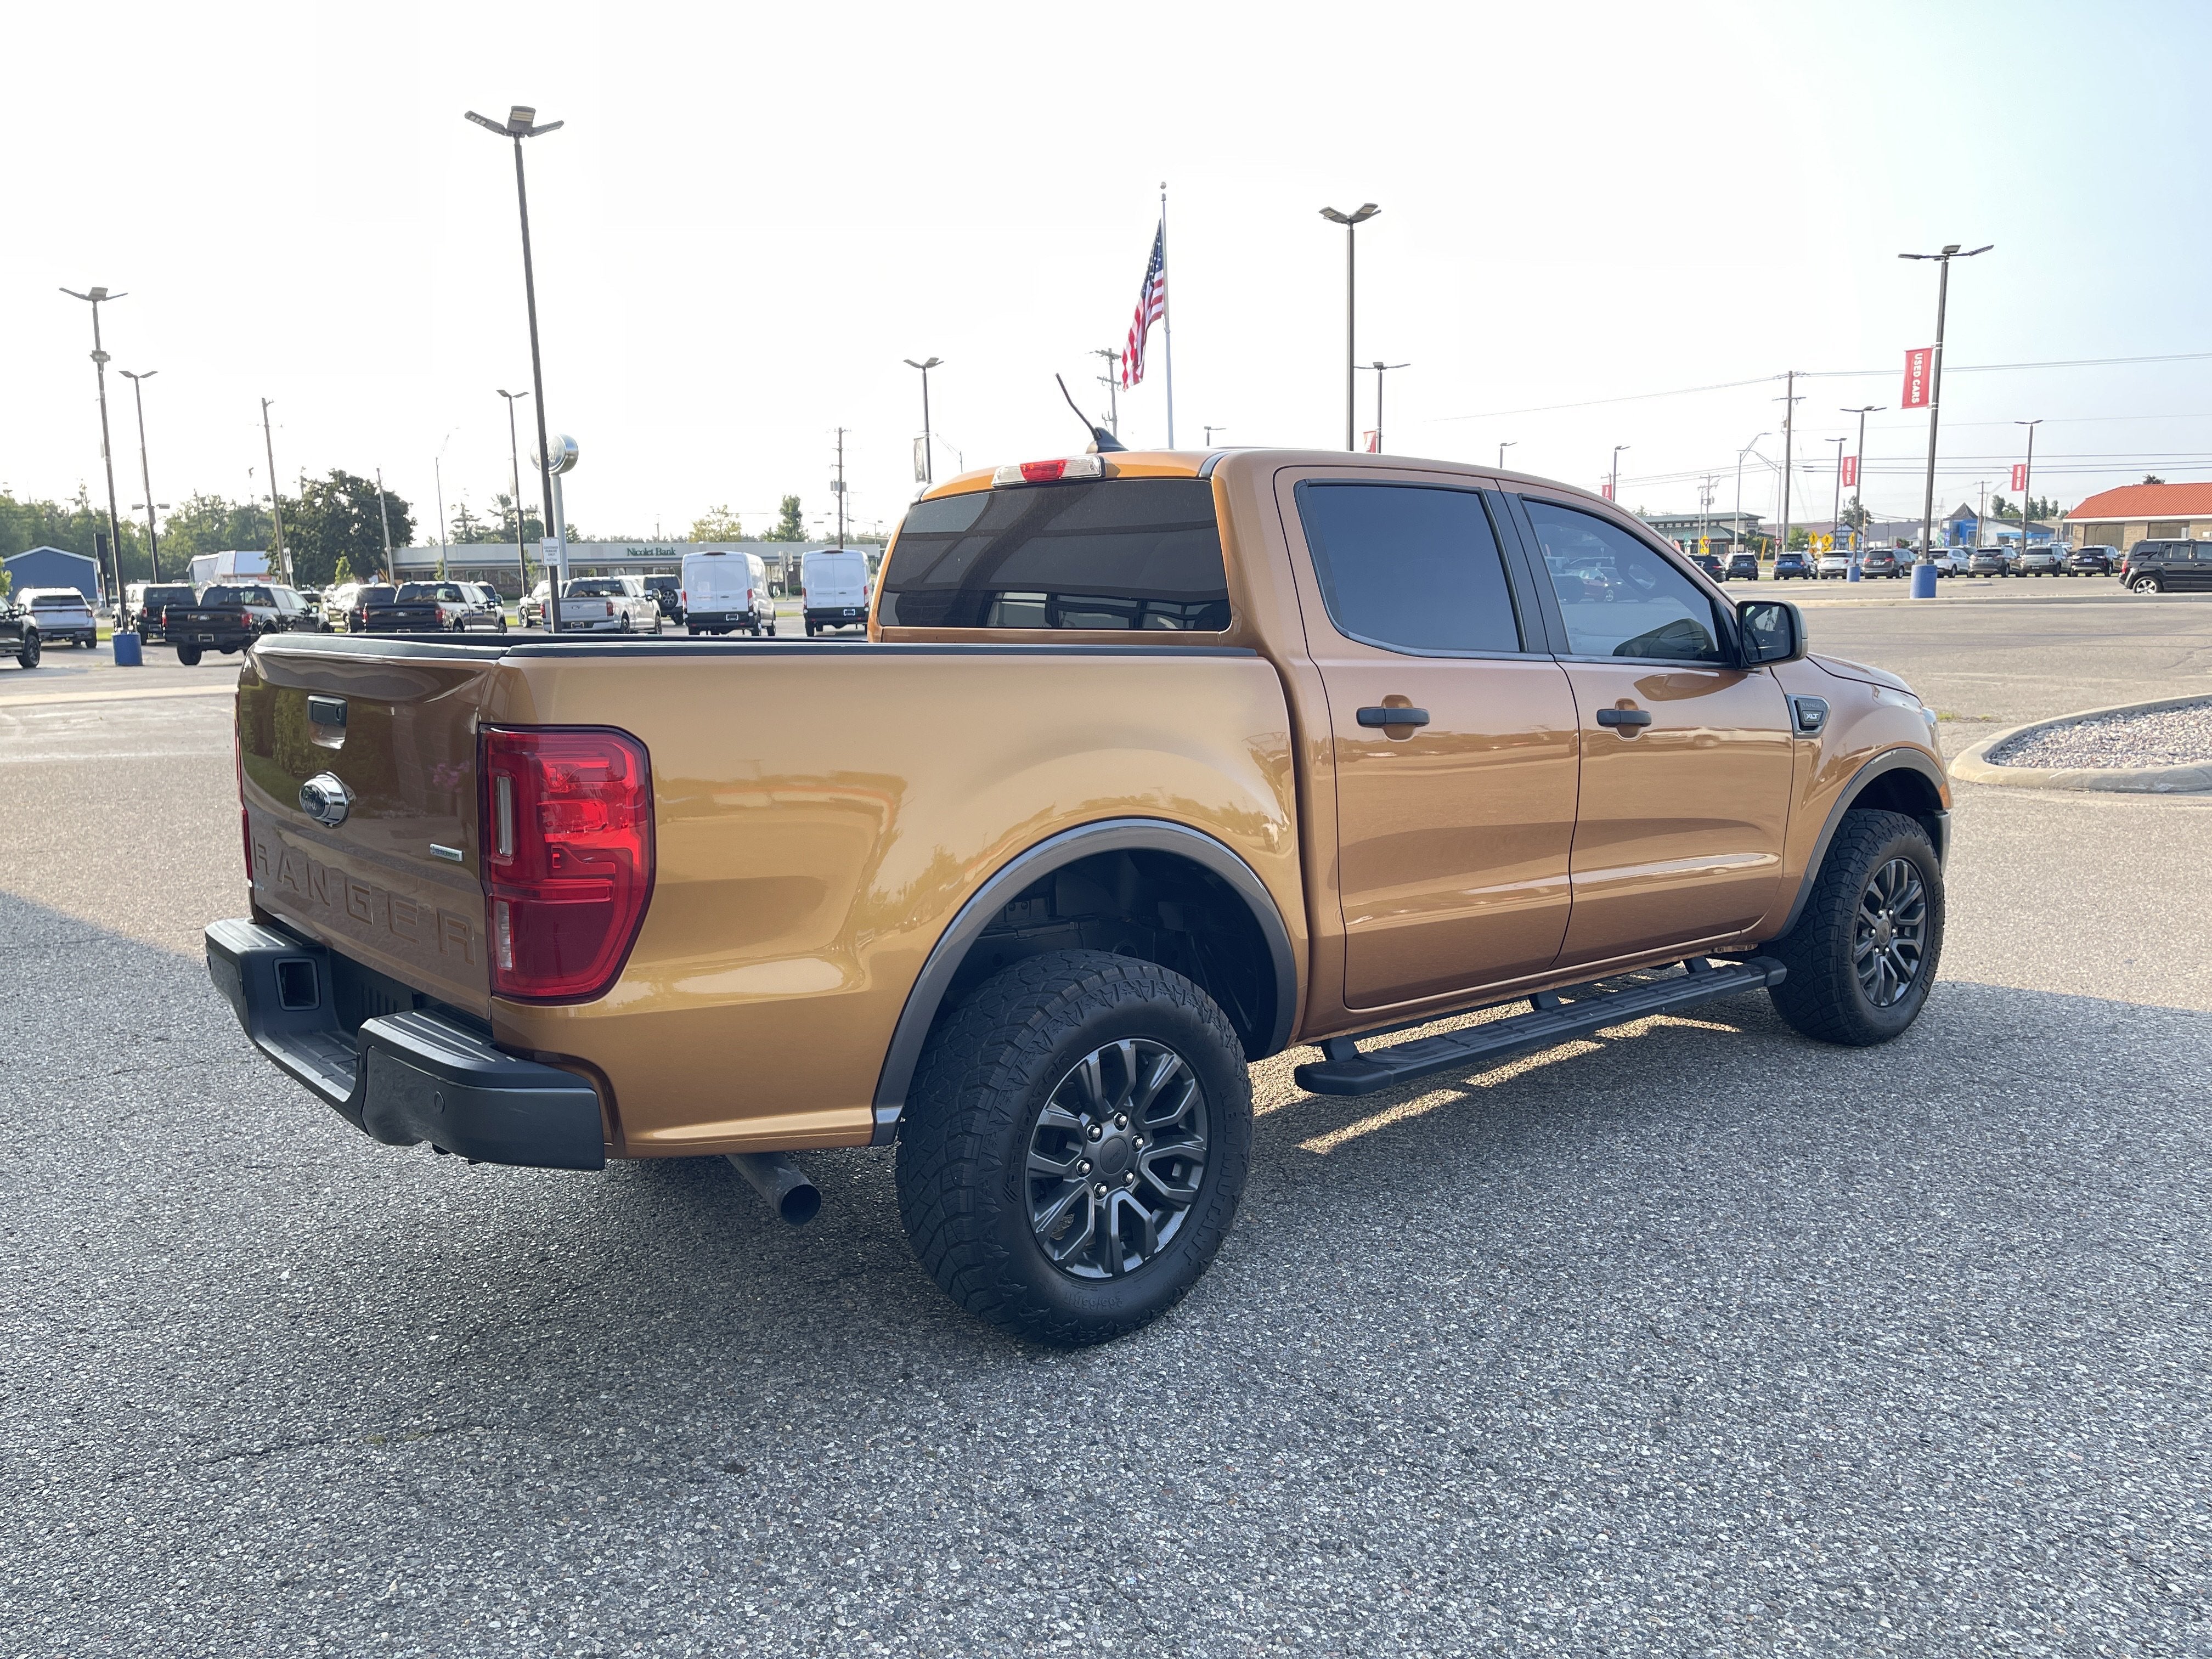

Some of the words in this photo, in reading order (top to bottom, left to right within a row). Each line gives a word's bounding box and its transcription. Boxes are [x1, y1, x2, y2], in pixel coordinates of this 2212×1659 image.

[1913, 353, 1923, 377] USED
[1911, 379, 1921, 404] CARS
[627, 547, 653, 556] Nicolet
[656, 547, 676, 556] Bank
[253, 836, 476, 966] RANGER
[1007, 1050, 1069, 1187] PREDATOR
[1220, 1091, 1238, 1146] NEW
